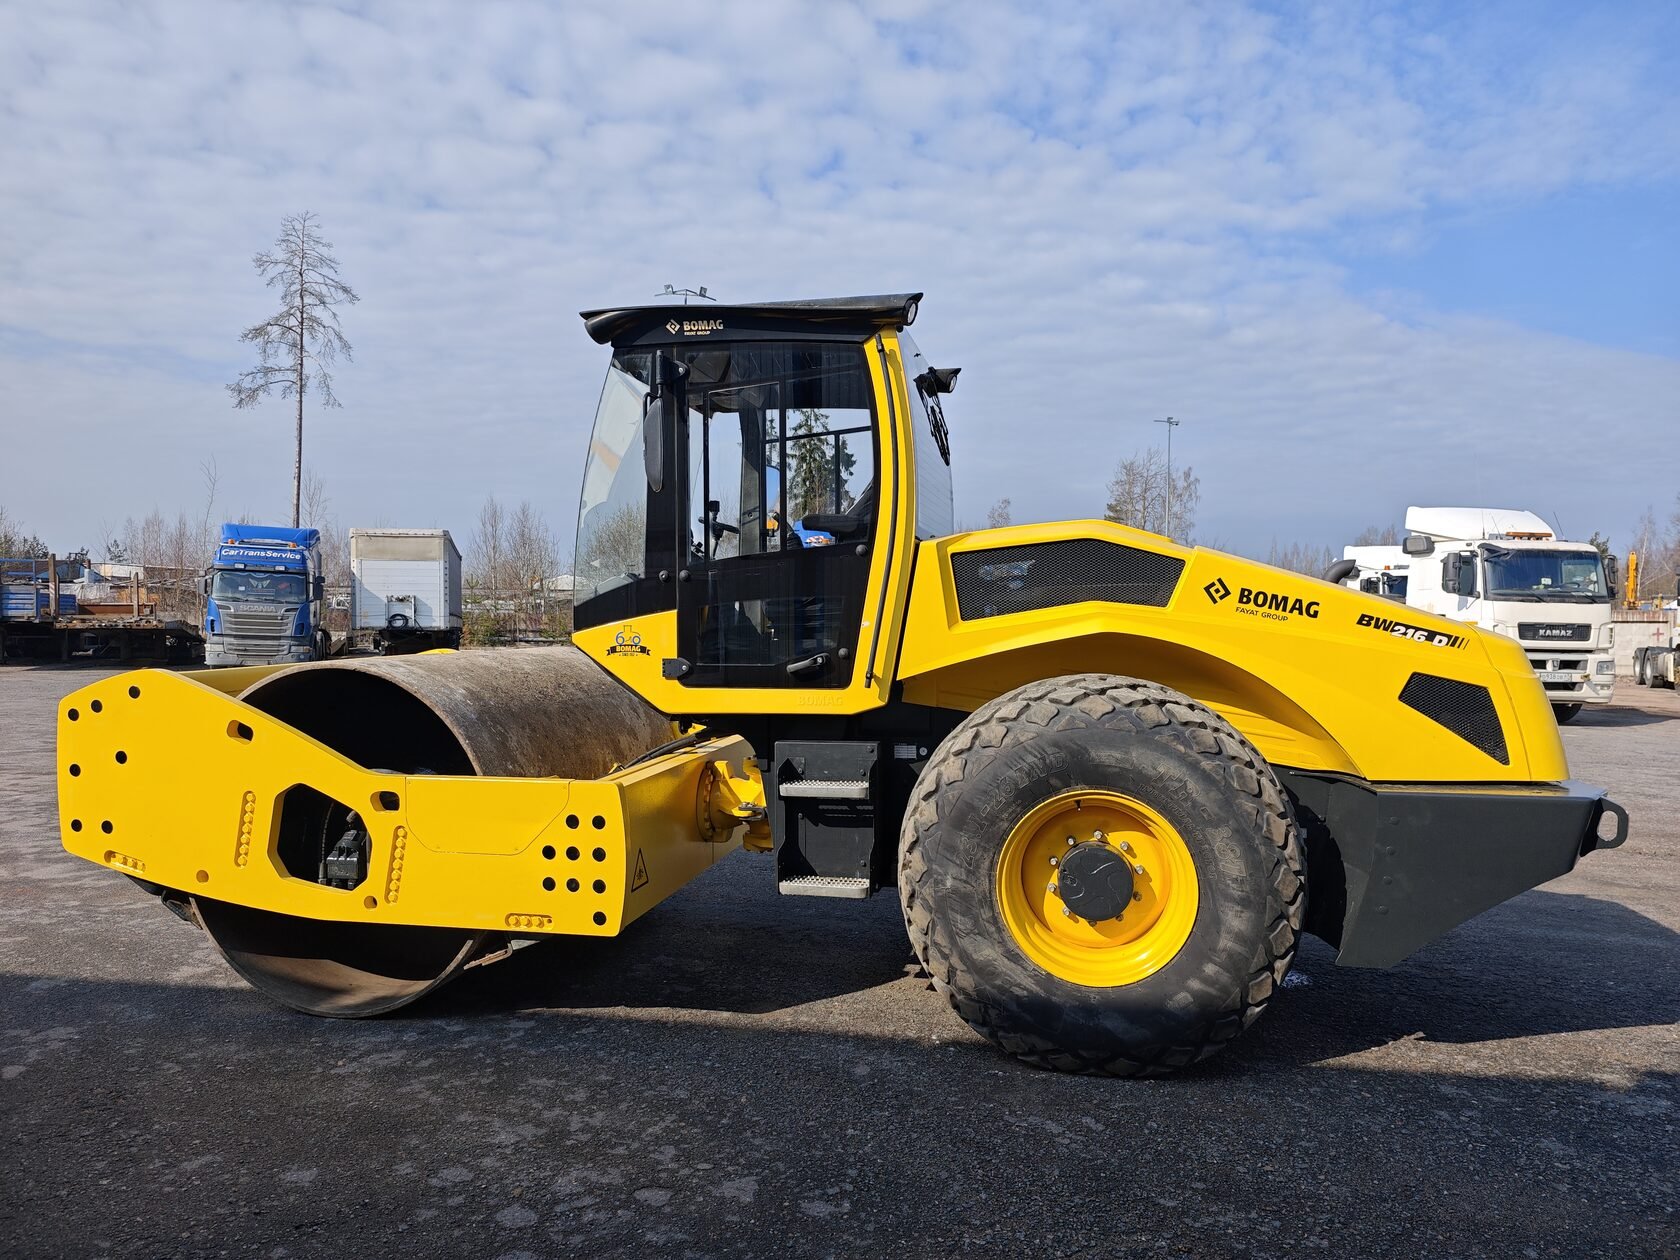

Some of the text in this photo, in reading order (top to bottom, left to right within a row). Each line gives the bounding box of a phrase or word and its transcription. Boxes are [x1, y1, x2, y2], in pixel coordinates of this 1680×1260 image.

[683, 320, 724, 331] BOMAG
[222, 548, 301, 559] CarTransService
[1238, 588, 1321, 619] BOMAG
[1235, 607, 1288, 622] FAYAT GROUP
[1539, 629, 1573, 637] KAMAZ
[799, 695, 844, 706] BOMAG
